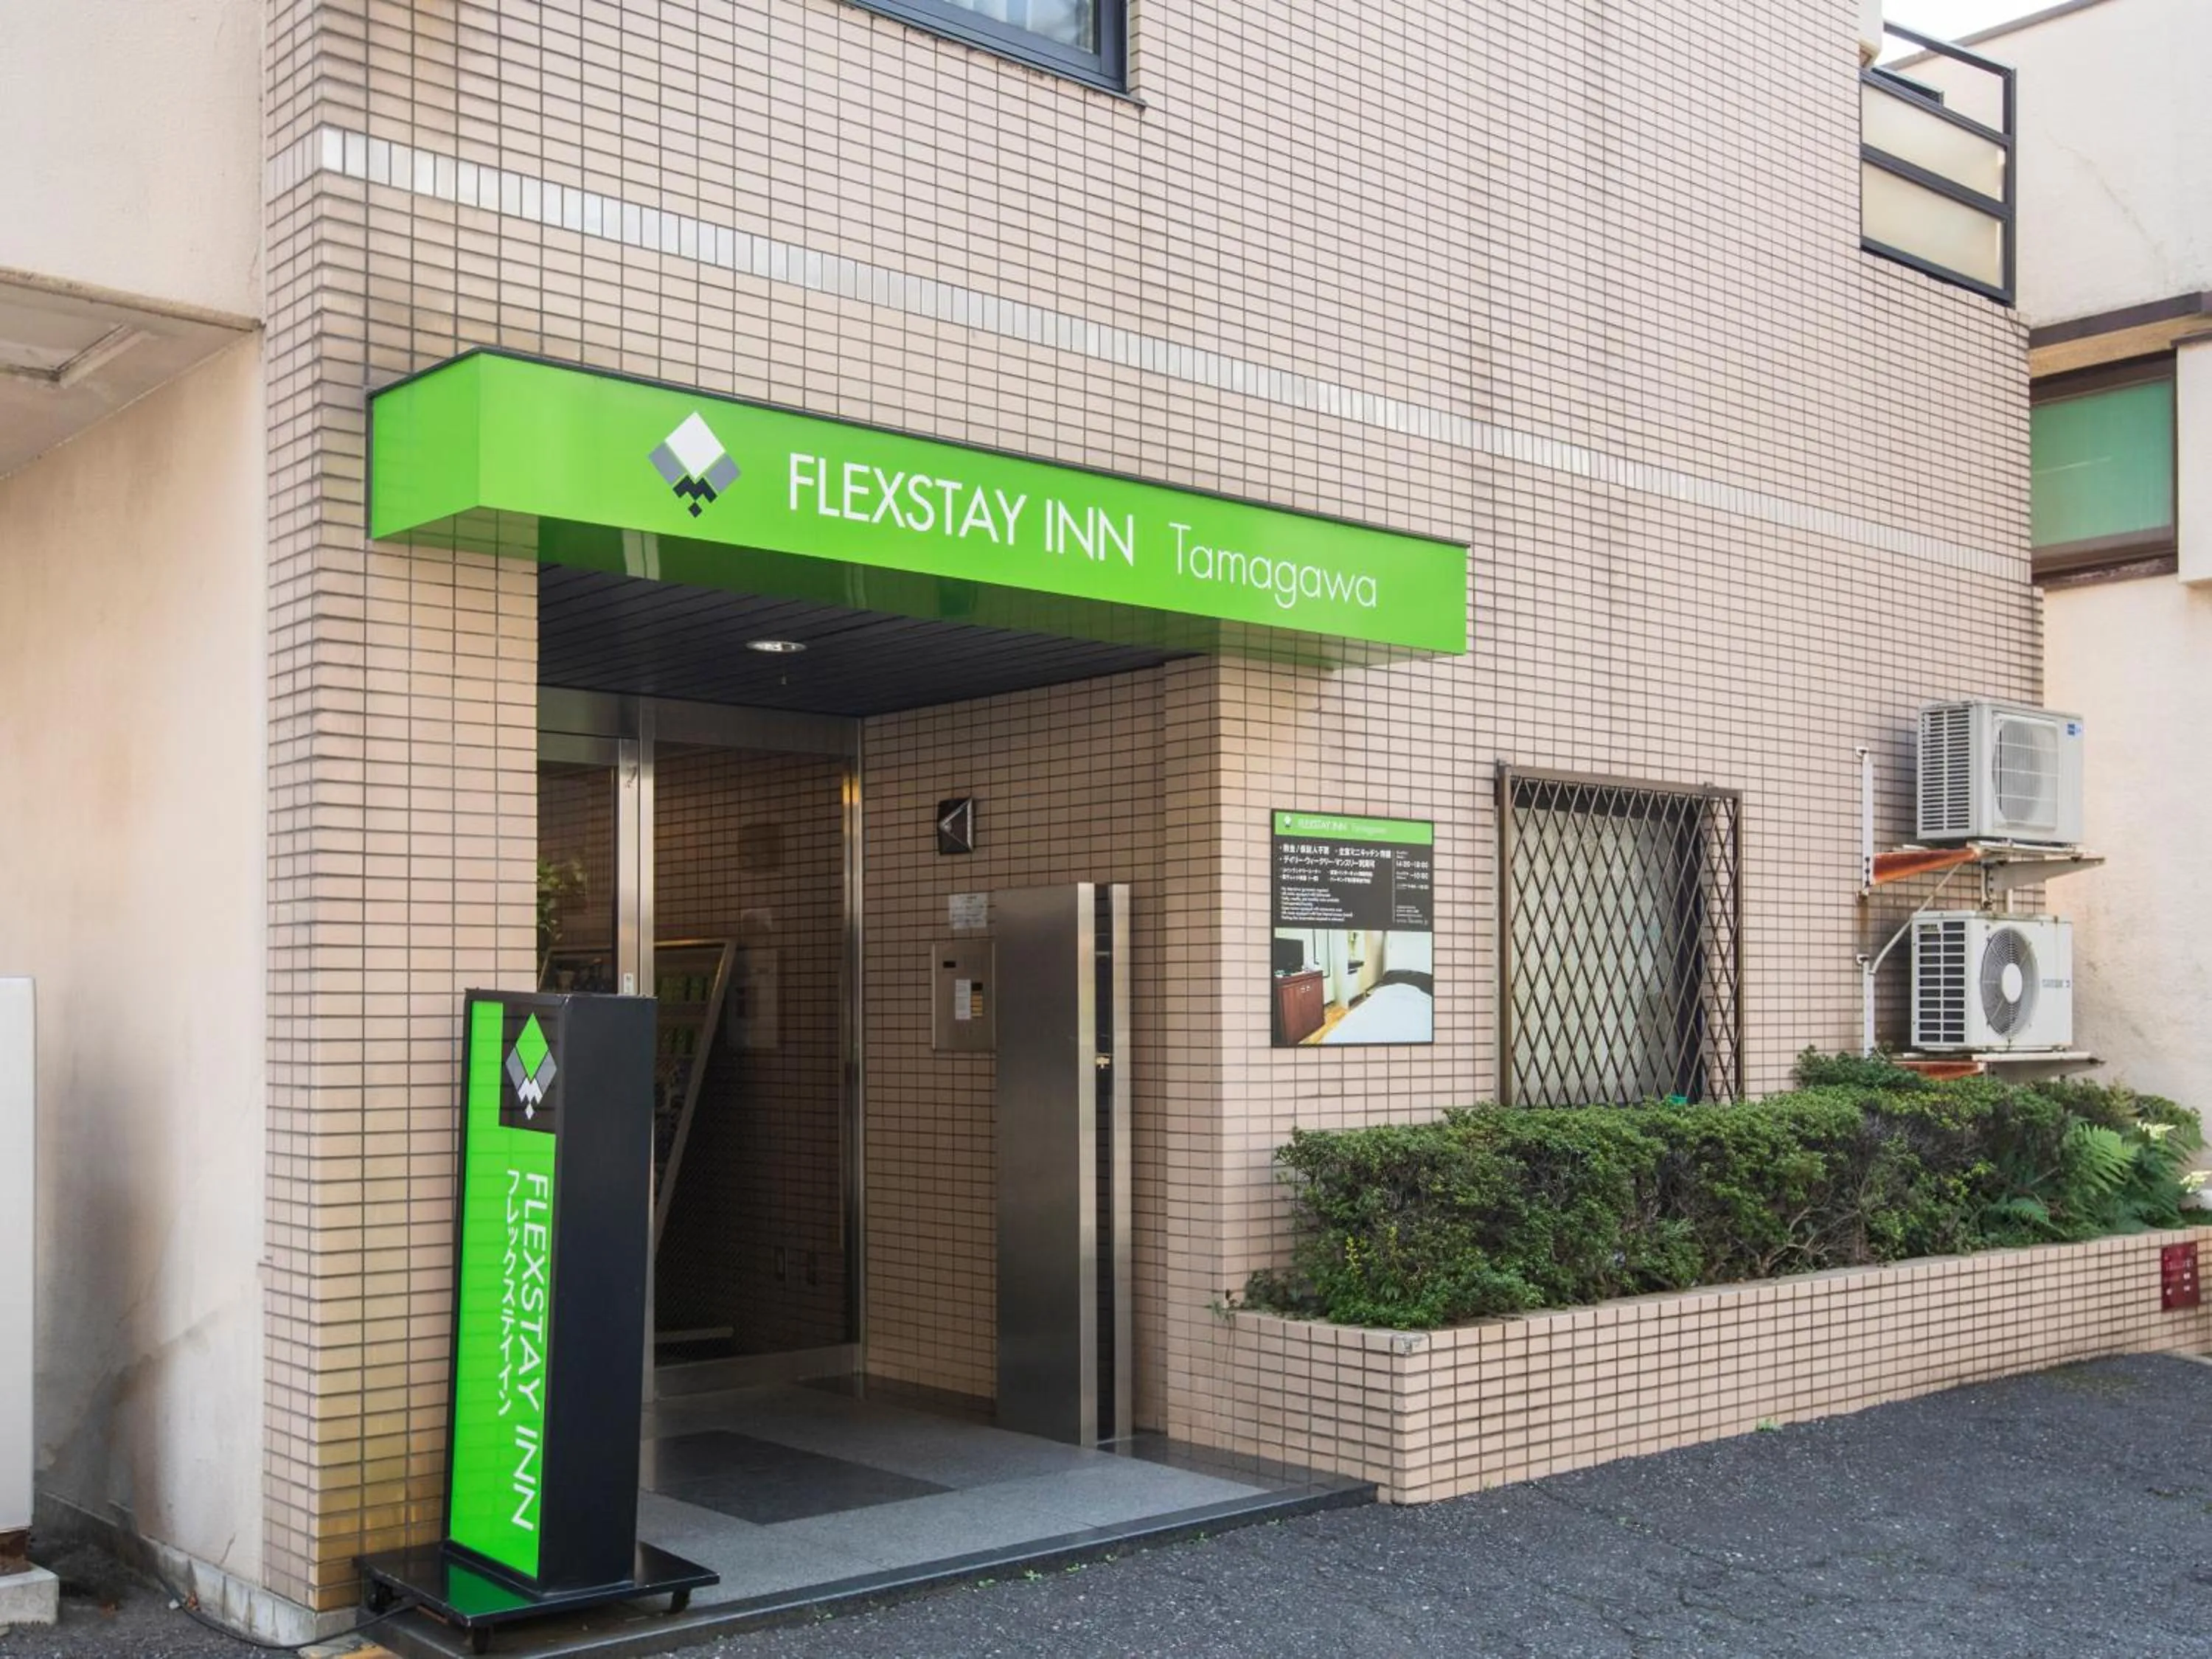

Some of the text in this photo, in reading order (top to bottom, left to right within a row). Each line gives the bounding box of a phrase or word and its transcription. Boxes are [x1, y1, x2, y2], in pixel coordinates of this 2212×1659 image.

[789, 451, 1377, 609] FLEXSTAY INN Tamagawa
[498, 1169, 520, 1416] フレックステイイン
[510, 1172, 549, 1531] FLEXSTAY INN
